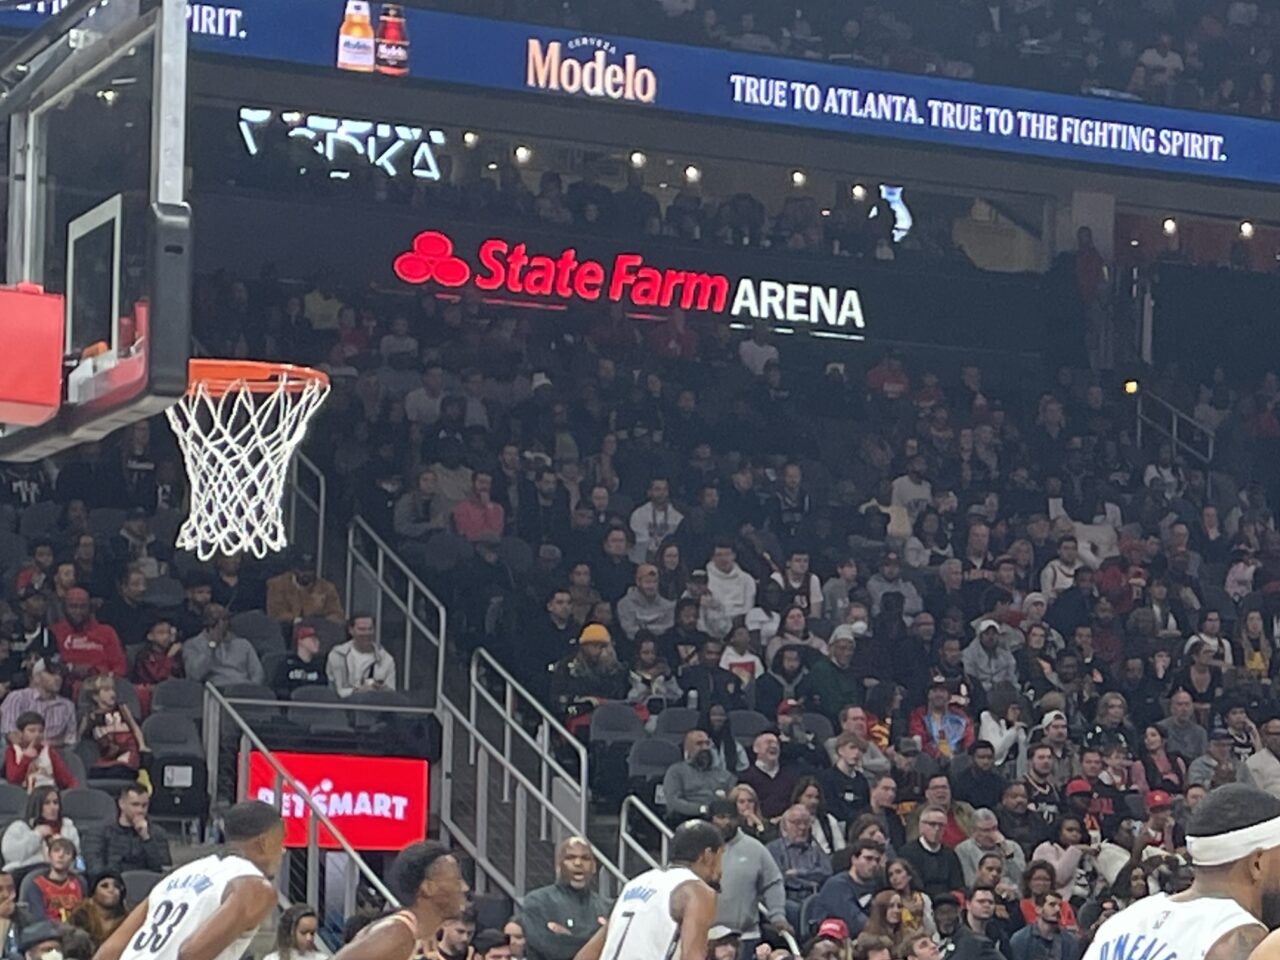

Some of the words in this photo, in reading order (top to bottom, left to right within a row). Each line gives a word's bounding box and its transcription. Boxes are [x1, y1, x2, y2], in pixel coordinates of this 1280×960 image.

[185, 4, 247, 38] IRIT.
[527, 38, 656, 103] Modelo
[730, 74, 788, 107] TRUE
[790, 82, 821, 111] TO
[823, 87, 925, 125] ATLANTA.
[927, 99, 983, 132] TRUE
[985, 106, 1014, 135] TO
[1017, 110, 1058, 141] THE
[1061, 117, 1156, 153] FIGHTING
[1158, 129, 1227, 161] SPIRIT.
[475, 239, 605, 299] State
[608, 254, 729, 312] Farm
[730, 278, 865, 328] ARENA
[133, 899, 189, 954] 33
